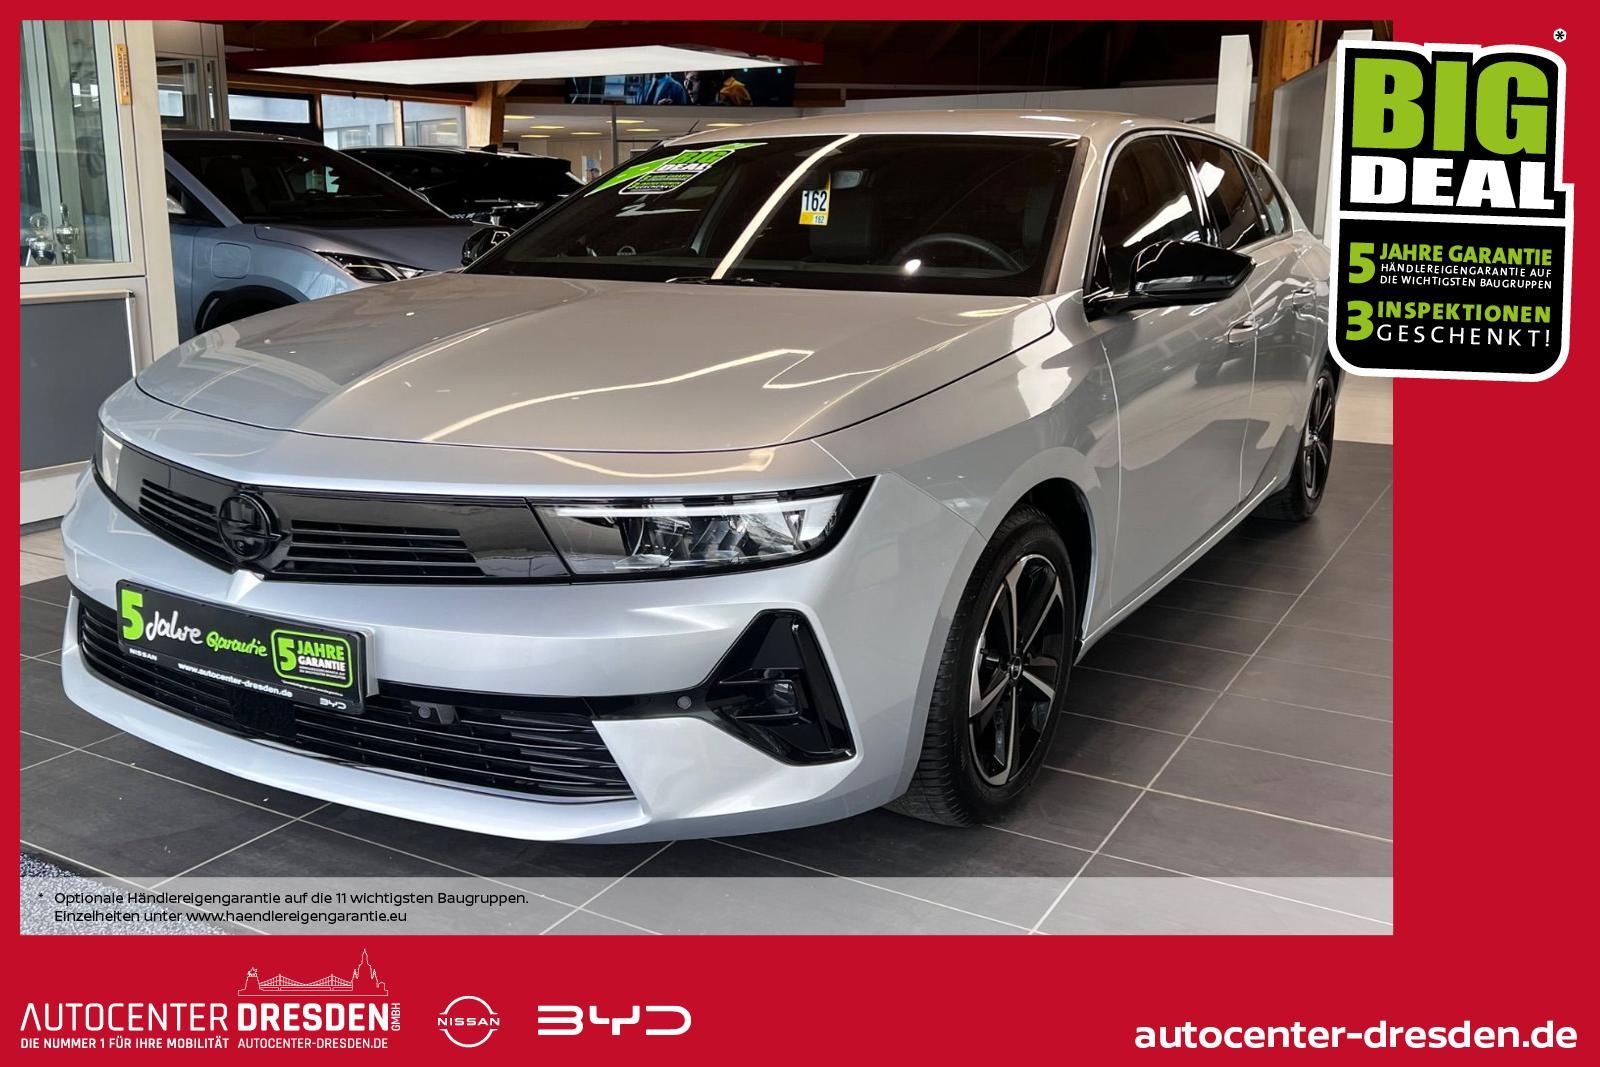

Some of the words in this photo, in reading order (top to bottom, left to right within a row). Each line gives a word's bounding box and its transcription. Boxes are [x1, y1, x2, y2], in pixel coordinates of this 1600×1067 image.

[803, 190, 828, 212] 162
[121, 588, 145, 640] 5
[145, 610, 203, 644] Jahre
[206, 631, 268, 657] Garantie
[129, 647, 158, 661] NISSAN
[277, 636, 297, 671] 5
[297, 640, 345, 661] JAHRE
[297, 655, 347, 672] GARANTIE
[178, 662, 293, 698] www.autocenter-dresden.de
